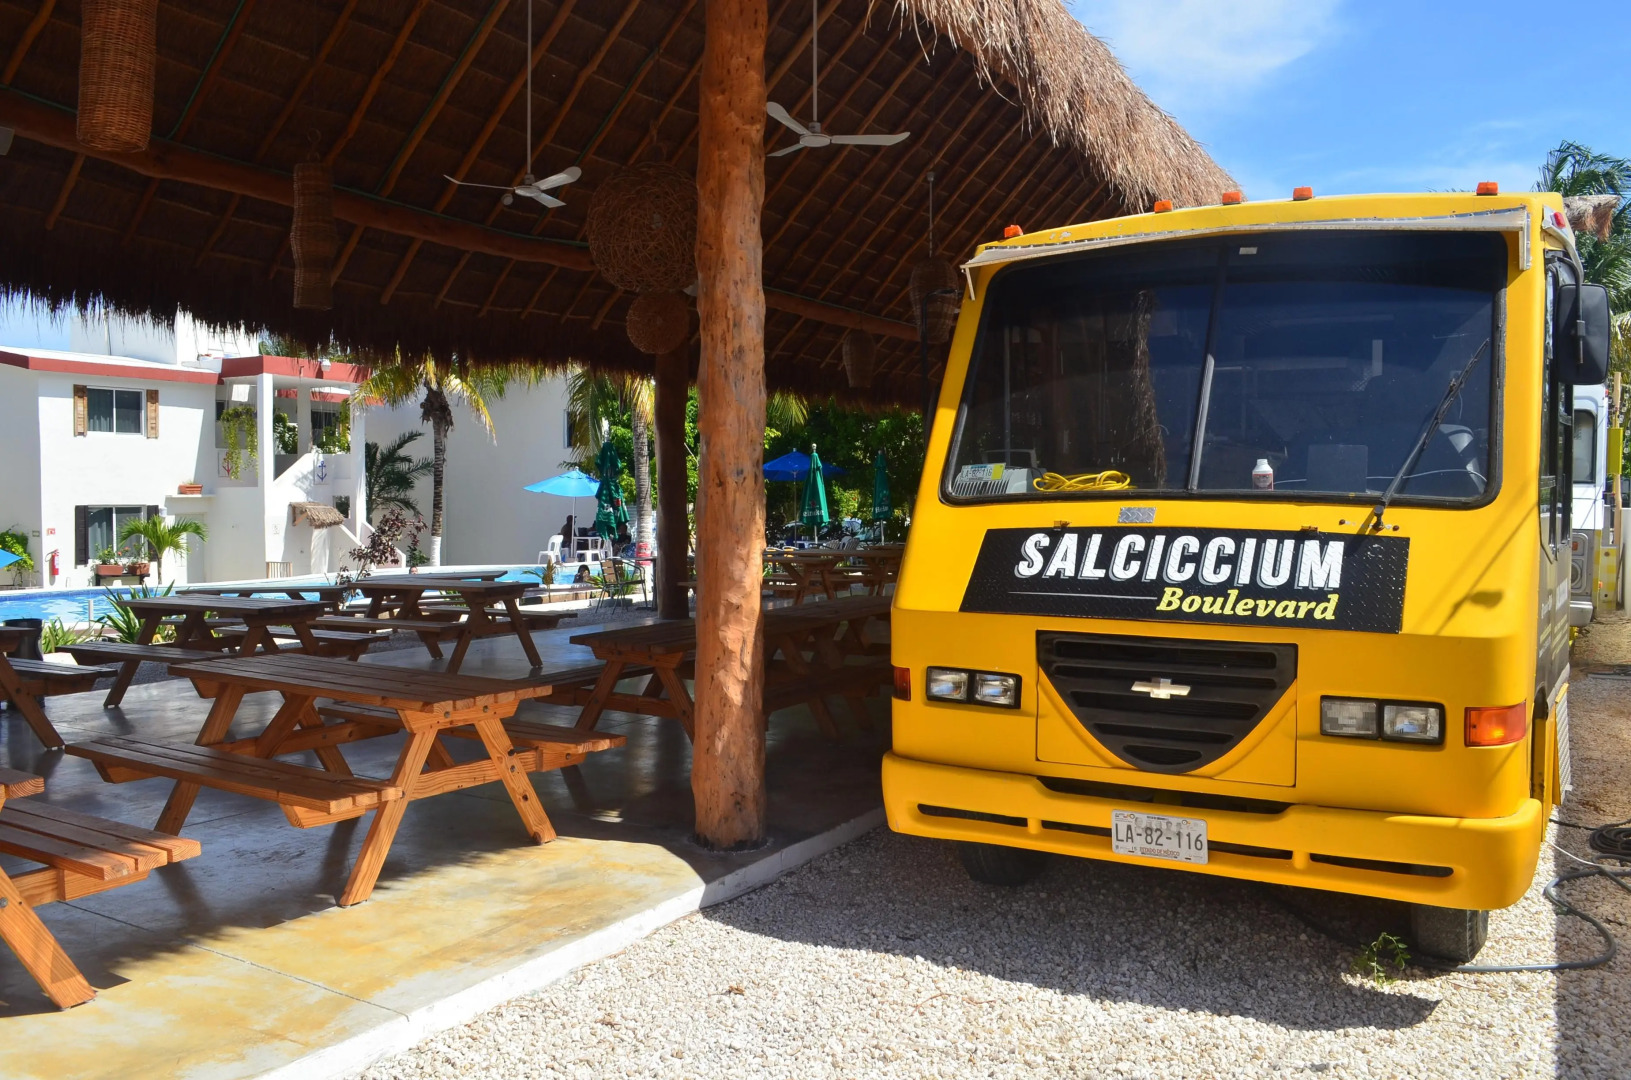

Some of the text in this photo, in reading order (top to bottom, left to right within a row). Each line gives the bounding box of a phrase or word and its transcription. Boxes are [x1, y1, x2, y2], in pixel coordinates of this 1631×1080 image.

[1014, 532, 1345, 590] SALCICCIUM
[1156, 586, 1339, 621] Boulevard
[1115, 823, 1204, 851] LA-82-116
